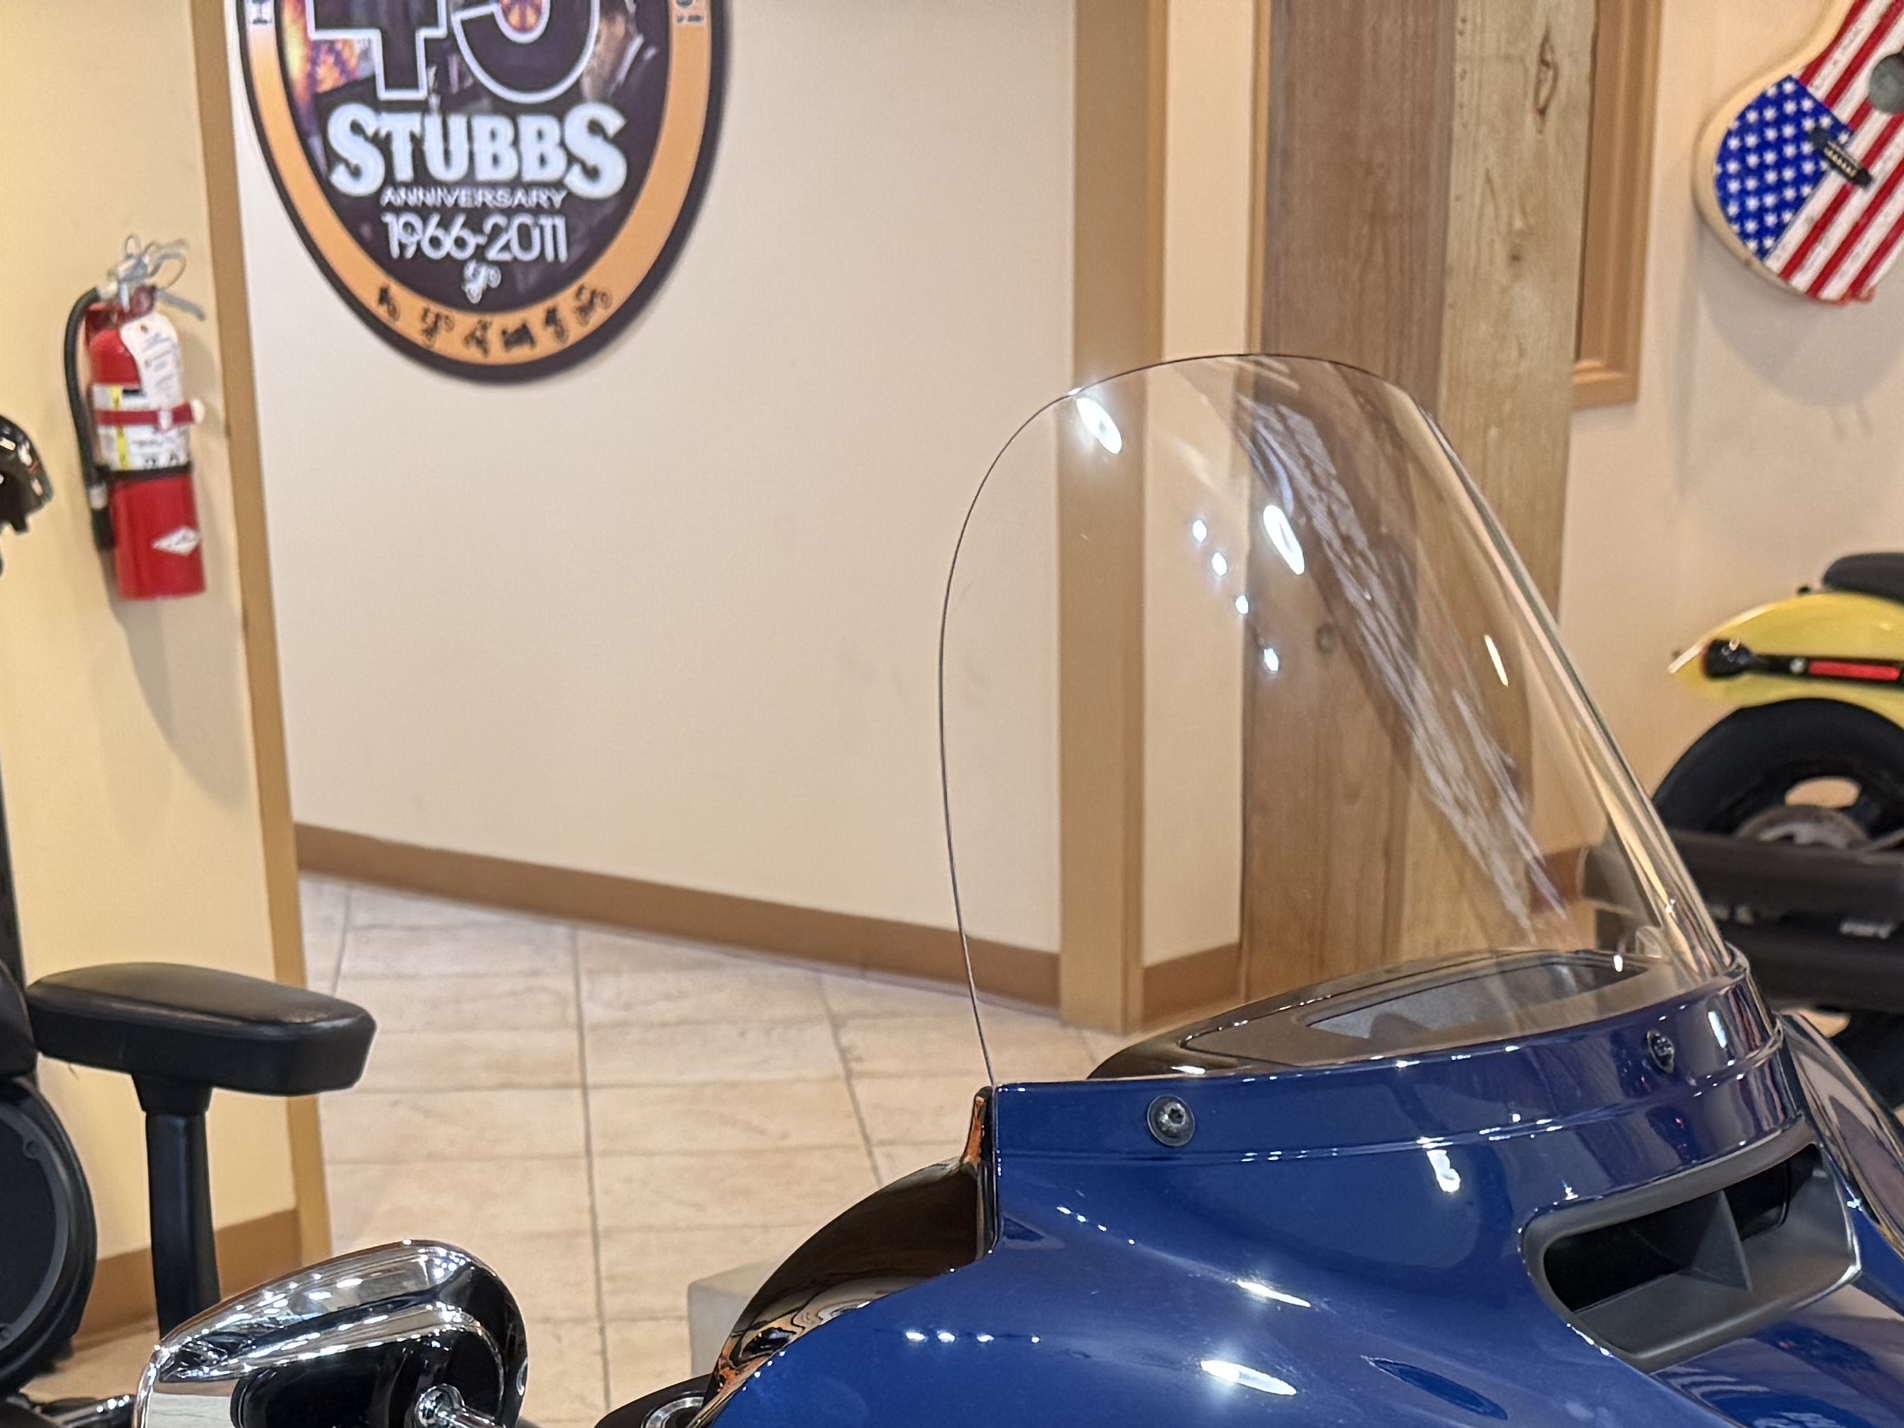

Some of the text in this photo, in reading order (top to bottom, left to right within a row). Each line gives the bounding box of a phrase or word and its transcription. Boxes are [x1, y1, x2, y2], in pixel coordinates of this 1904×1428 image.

[327, 102, 629, 199] STUBBS
[381, 186, 569, 209] ANNIVERSARY
[381, 211, 569, 263] 1966-2011
